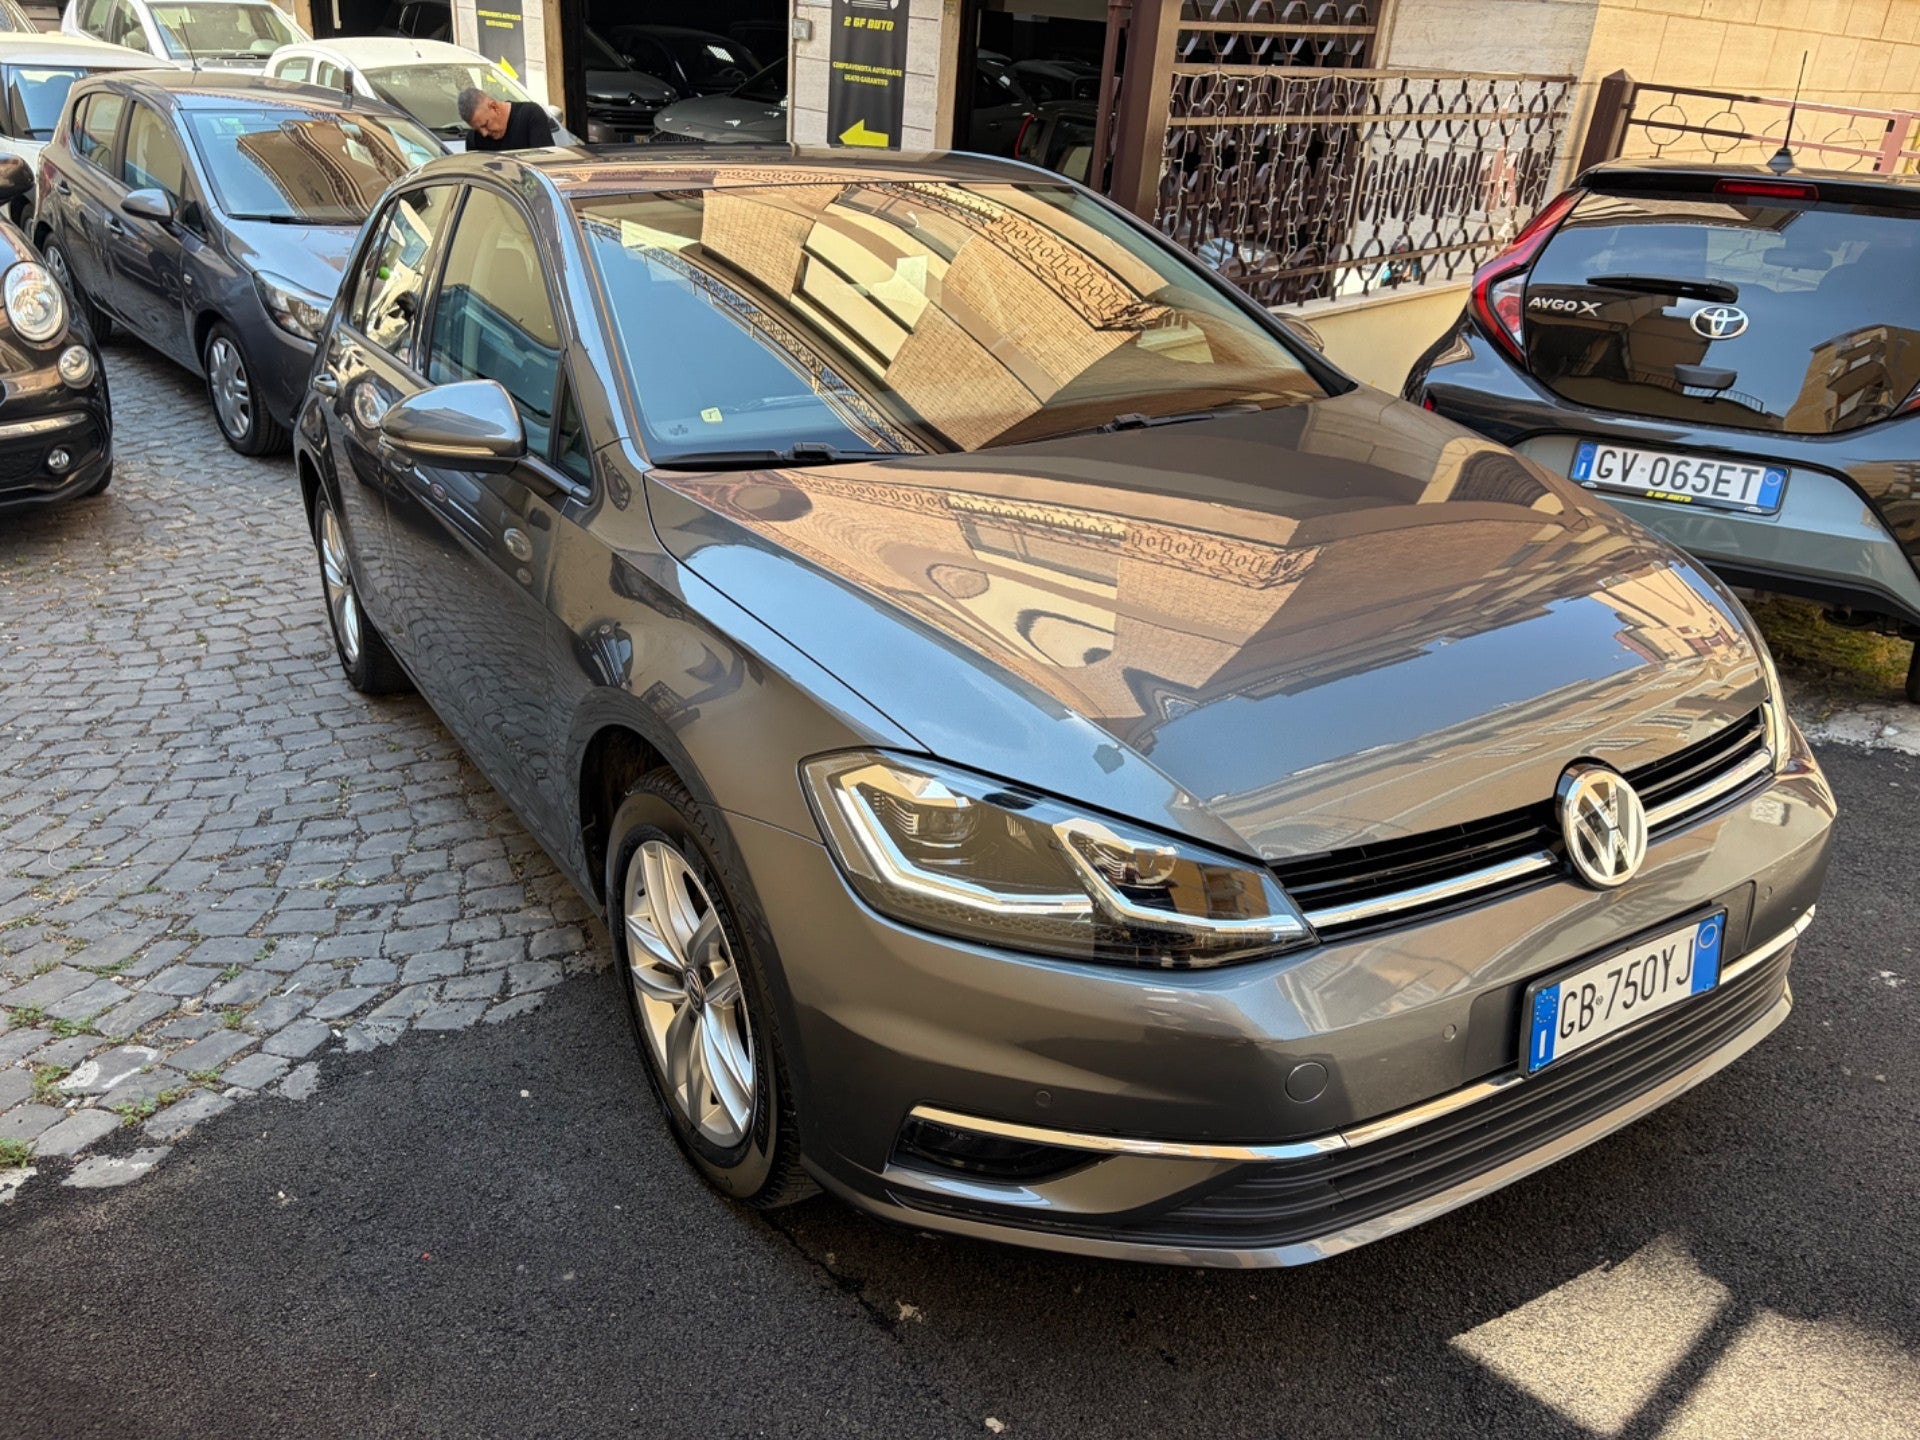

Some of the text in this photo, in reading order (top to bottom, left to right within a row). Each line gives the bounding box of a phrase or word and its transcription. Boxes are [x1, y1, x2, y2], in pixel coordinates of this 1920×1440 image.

[843, 16, 852, 26] 2
[1528, 296, 1603, 317] AYGO X
